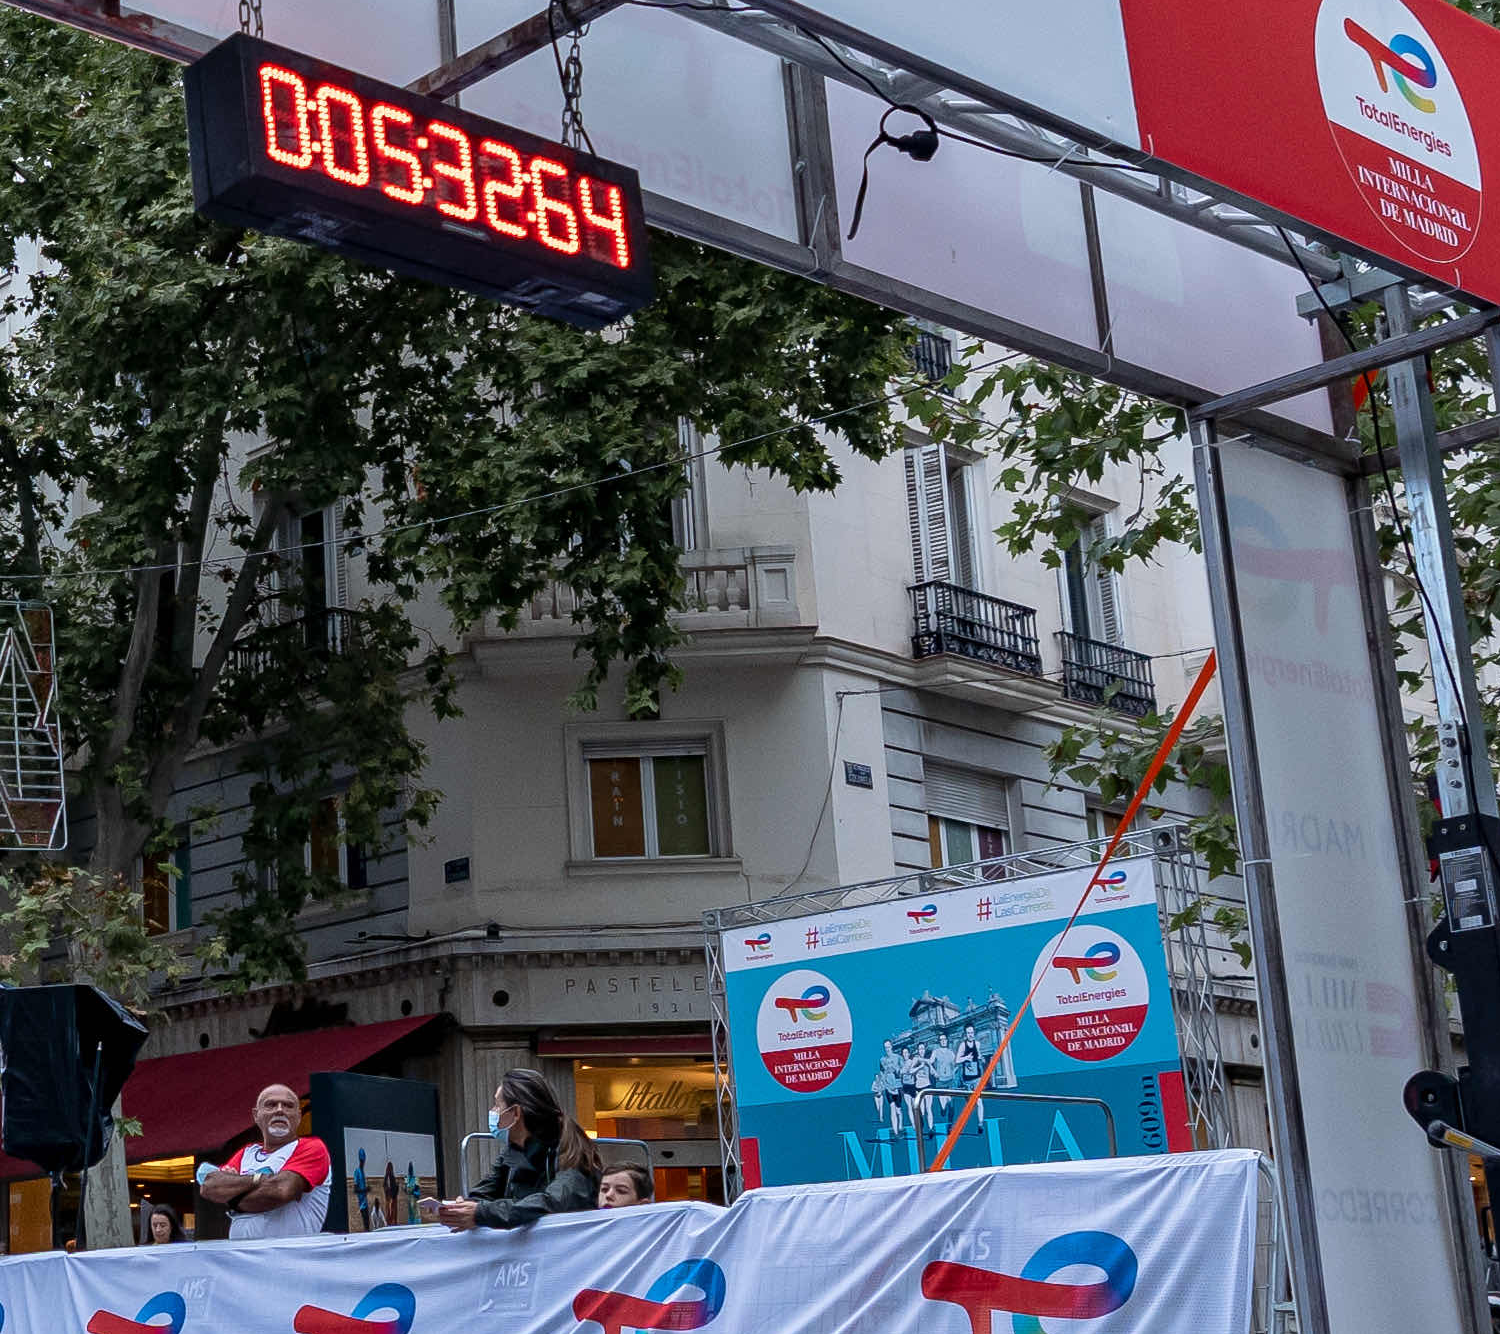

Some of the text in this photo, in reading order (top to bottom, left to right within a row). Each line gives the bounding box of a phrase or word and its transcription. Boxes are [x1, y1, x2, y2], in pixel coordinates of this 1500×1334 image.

[1355, 94, 1453, 157] TotalEnergies
[1388, 156, 1436, 194] MILLA
[1379, 197, 1459, 247] DE MADRID
[1056, 987, 1127, 1005] TotalEnergies
[636, 1002, 693, 1013] 1931
[1076, 1014, 1109, 1026] MILLA
[777, 1026, 835, 1043] TotalEnergies
[1067, 1037, 1125, 1052] DE MADRID
[793, 1049, 820, 1062] MILLA
[785, 1070, 834, 1085] DE MADRID
[494, 1261, 529, 1288] AMS
